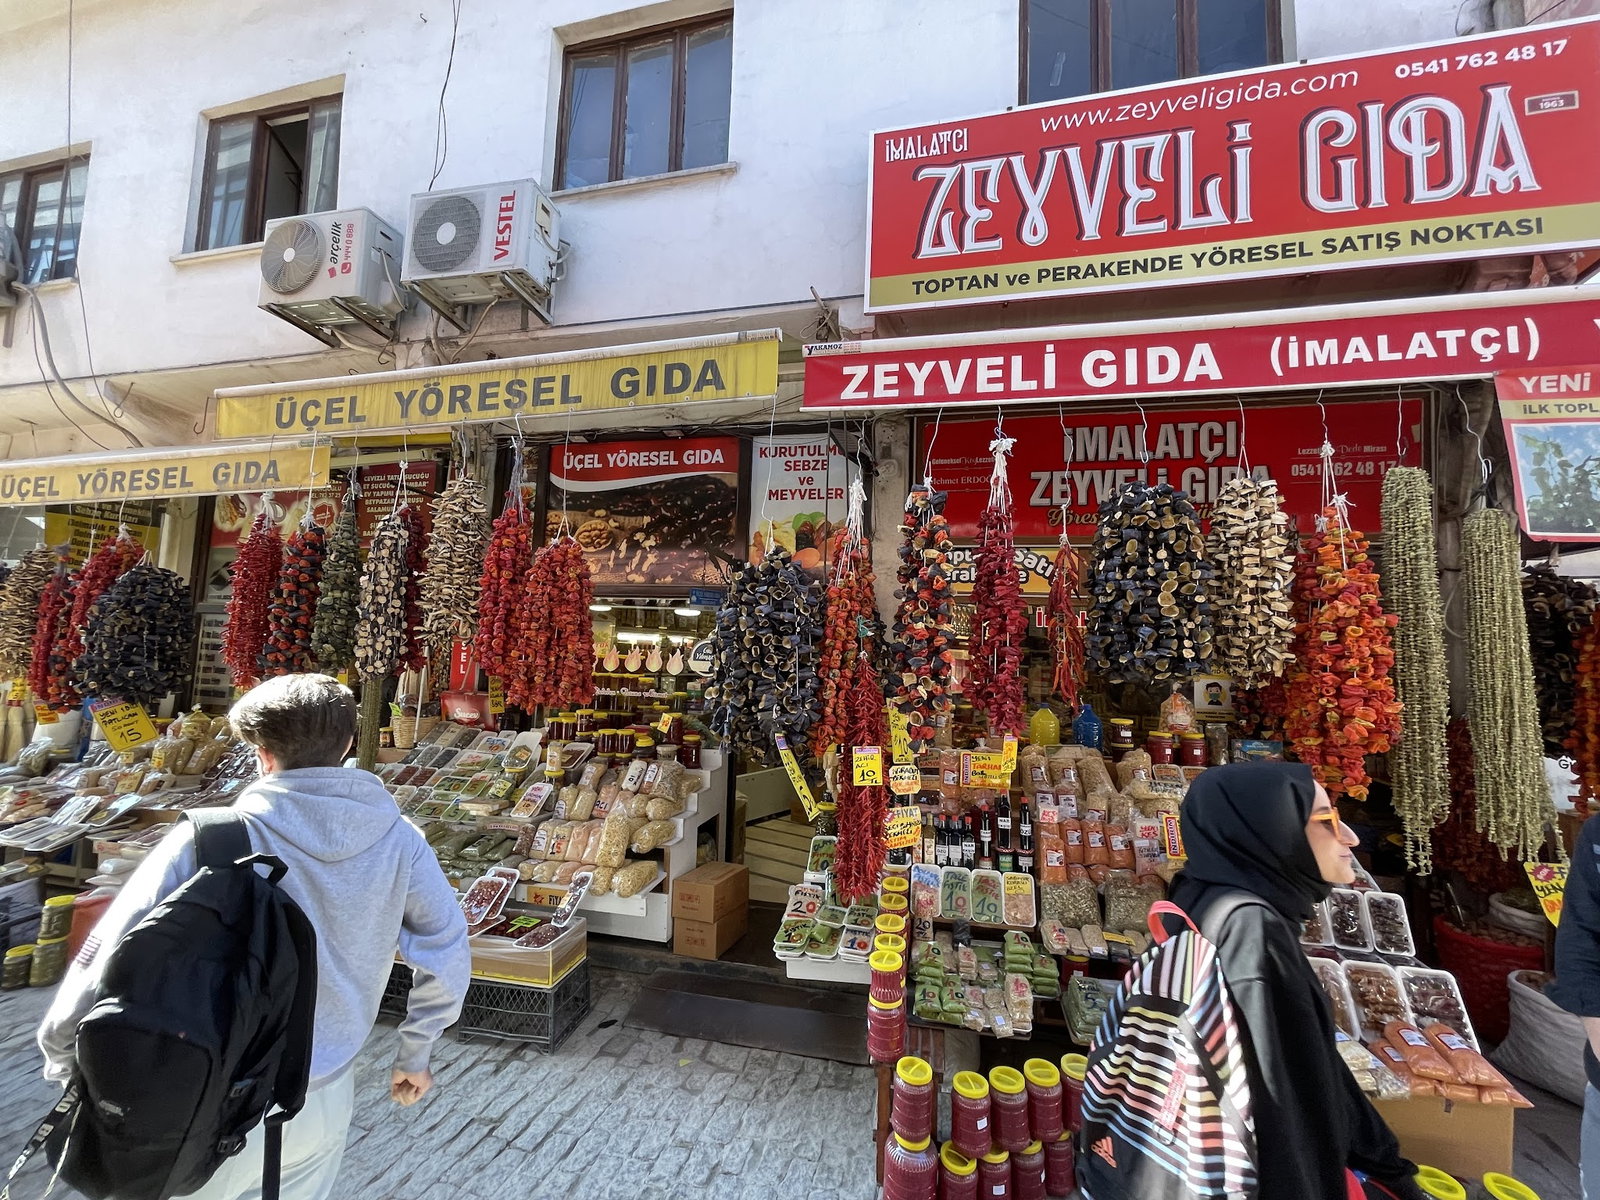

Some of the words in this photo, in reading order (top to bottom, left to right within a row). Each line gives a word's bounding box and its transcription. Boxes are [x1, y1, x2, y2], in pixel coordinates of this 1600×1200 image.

[1395, 58, 1449, 79] 0541
[1456, 50, 1498, 70] 762
[1504, 44, 1536, 63] 48
[1542, 39, 1569, 56] 17
[1040, 68, 1360, 133] www.zeyveligida.com
[916, 121, 1254, 260] ZEYVELİ
[1301, 83, 1542, 214] GIDA
[493, 190, 516, 262] VESTEL
[329, 221, 342, 265] arçelik
[343, 245, 352, 261] 444
[912, 272, 999, 296] TOPTAN
[1006, 271, 1030, 287] ve
[1036, 253, 1184, 284] PERAKENDE
[1190, 241, 1313, 269] YÖRESEL
[1320, 230, 1401, 255] SATIŞ
[1410, 216, 1543, 247] NOKTASI
[840, 343, 1056, 401] ZEYVELİ
[1081, 342, 1223, 388] GIDA
[1269, 317, 1540, 377] (İMALATÇI)
[1518, 372, 1592, 394] YENİ
[274, 394, 367, 433] ÜÇEL
[394, 373, 583, 419] YÖRESEL
[610, 358, 726, 400] GIDA
[1522, 403, 1550, 415] İLK
[1063, 420, 1237, 463] İMALATÇI
[563, 450, 604, 471] ÜÇEL
[606, 448, 681, 468] YÖRESEL
[683, 448, 725, 465] GIDA
[784, 459, 829, 472] SEBZE
[1291, 464, 1321, 477] 0541
[1355, 461, 1374, 476] 48
[0, 473, 60, 501] ÜÇEL
[76, 464, 194, 495] YÖRESEL
[212, 458, 281, 486] GIDA
[798, 476, 814, 486] ve
[768, 488, 844, 501] MEYVELER
[119, 727, 142, 743] 15
[858, 769, 876, 783] 10
[791, 900, 817, 914] 20
